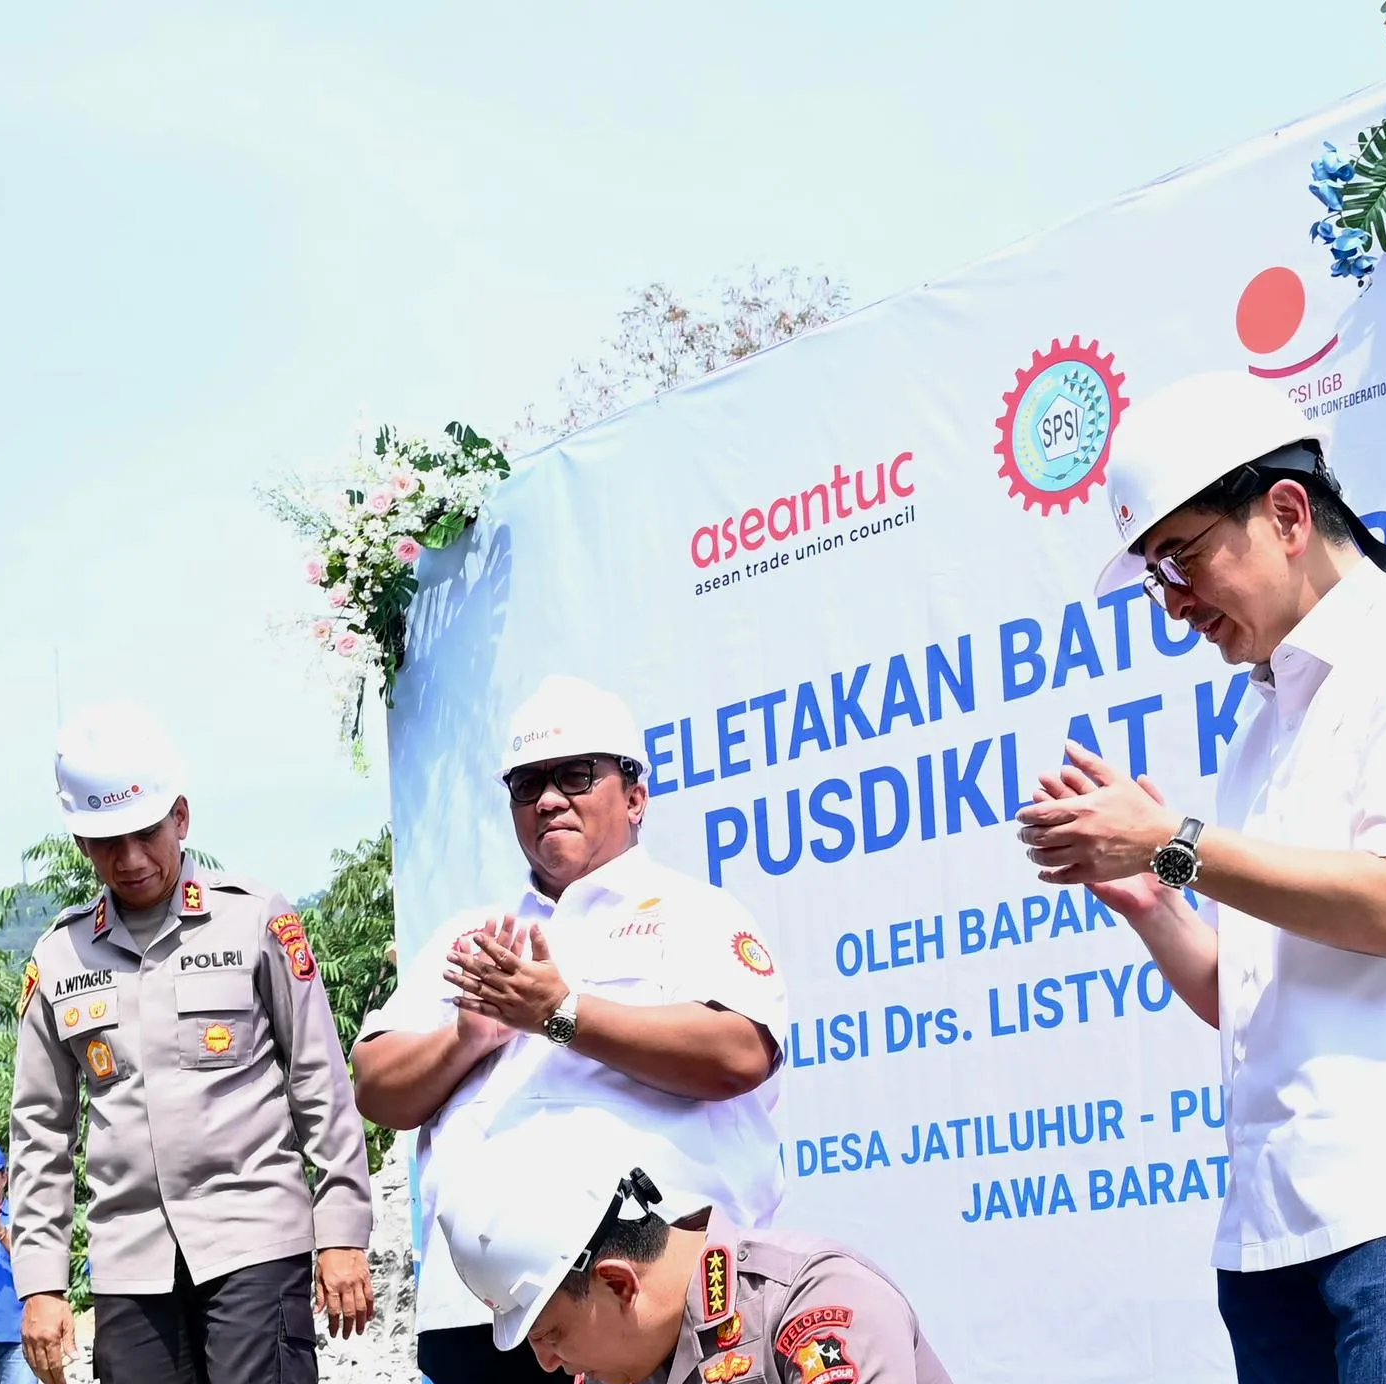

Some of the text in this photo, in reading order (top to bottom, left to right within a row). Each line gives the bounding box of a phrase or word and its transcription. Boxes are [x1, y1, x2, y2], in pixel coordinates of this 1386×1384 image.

[1317, 373, 1343, 396] IGB
[1042, 407, 1079, 448] SPSI
[691, 451, 915, 569] aseantuc
[695, 504, 916, 596] asean trade union council
[644, 633, 976, 798] ELETAKAN
[103, 789, 131, 804] atuc
[180, 950, 244, 971] POLRI
[835, 914, 946, 977] OLEH
[958, 883, 1117, 955] BAPAK
[55, 969, 113, 997] A.WIYAGUS
[783, 1010, 869, 1068] LISI
[885, 1004, 973, 1053] Drs.
[988, 959, 1174, 1037] LISTYO
[797, 1130, 891, 1177] DESA
[900, 1099, 1126, 1166] JATILUHUR
[961, 1154, 1231, 1223] JAWA BARAT
[782, 1309, 845, 1353] PELOPOR
